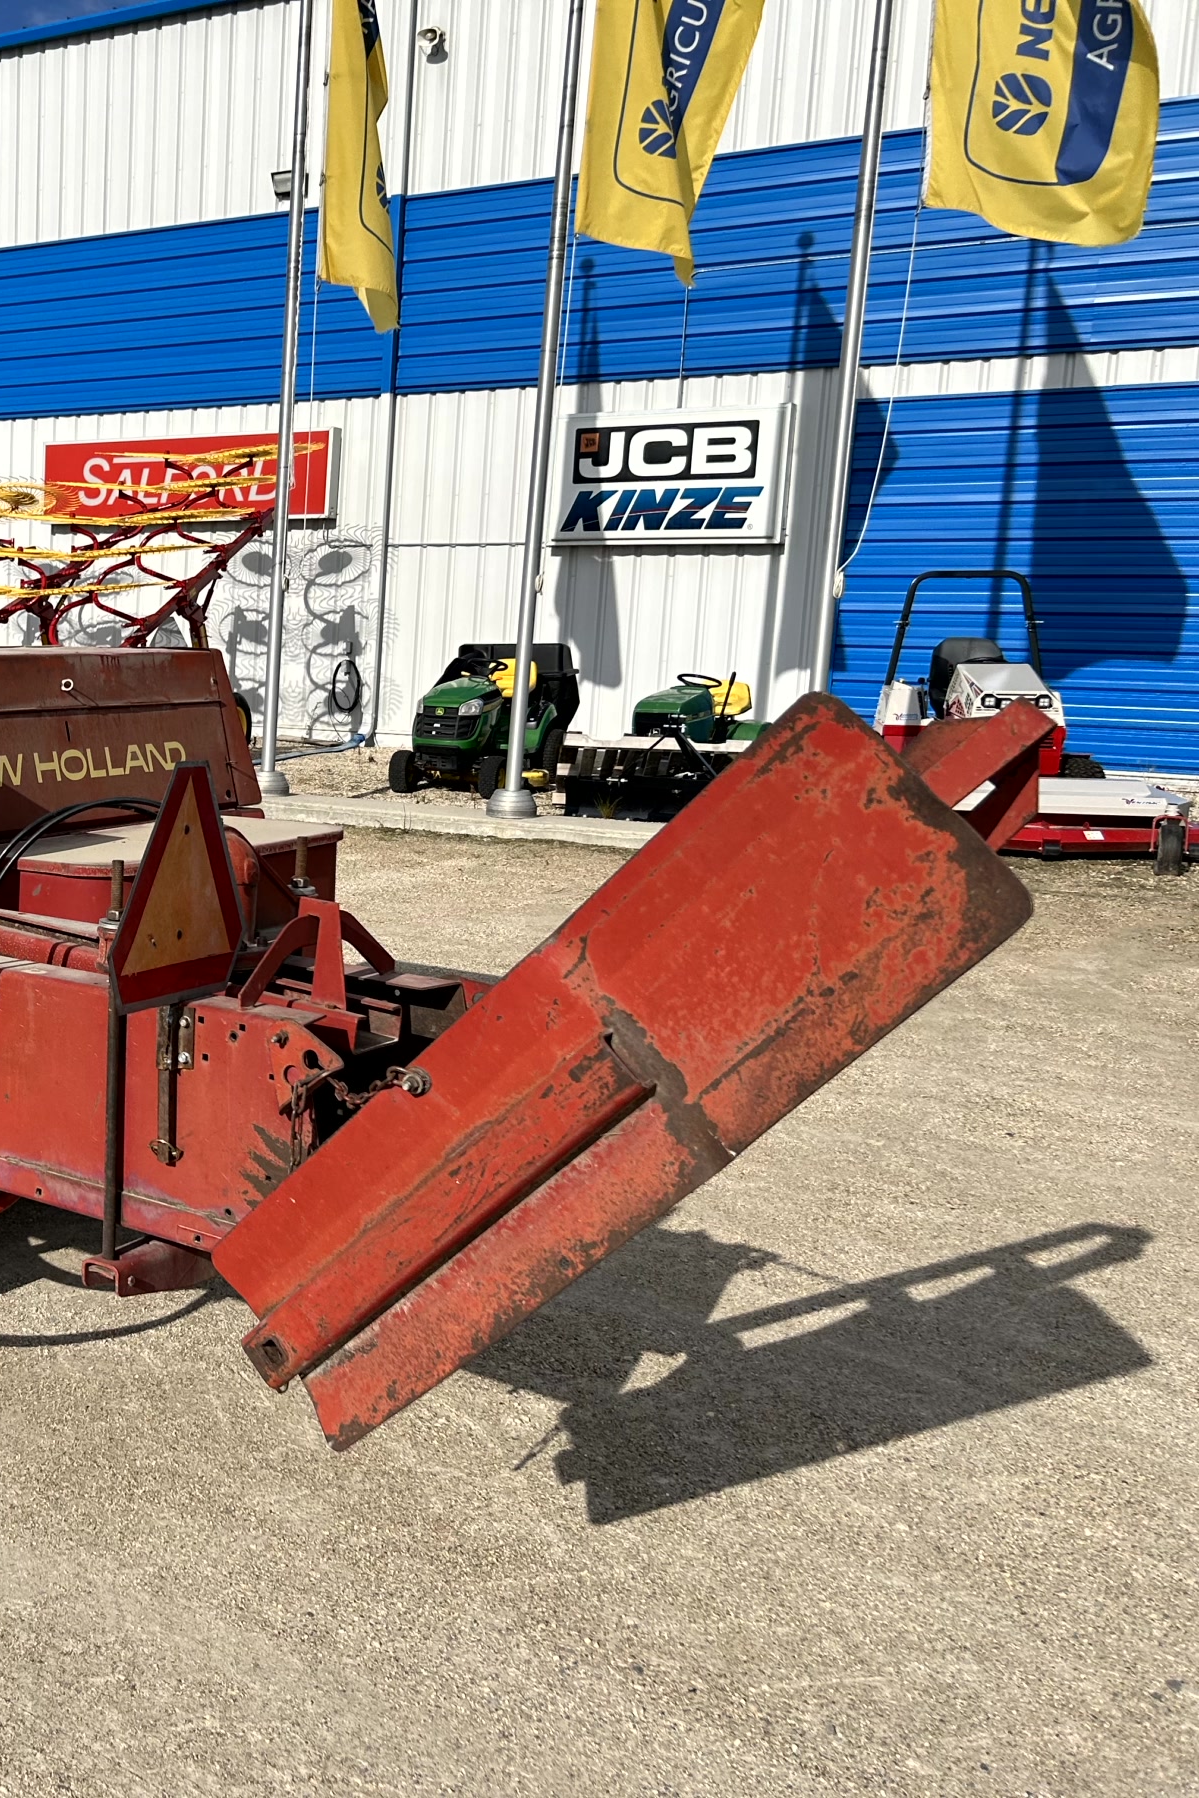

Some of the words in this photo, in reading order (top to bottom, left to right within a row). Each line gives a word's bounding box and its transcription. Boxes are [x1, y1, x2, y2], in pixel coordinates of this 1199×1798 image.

[666, 0, 707, 120] GRICU
[578, 426, 752, 479] JCB
[560, 486, 765, 532] KINZE
[34, 741, 187, 785] HOLLAND
